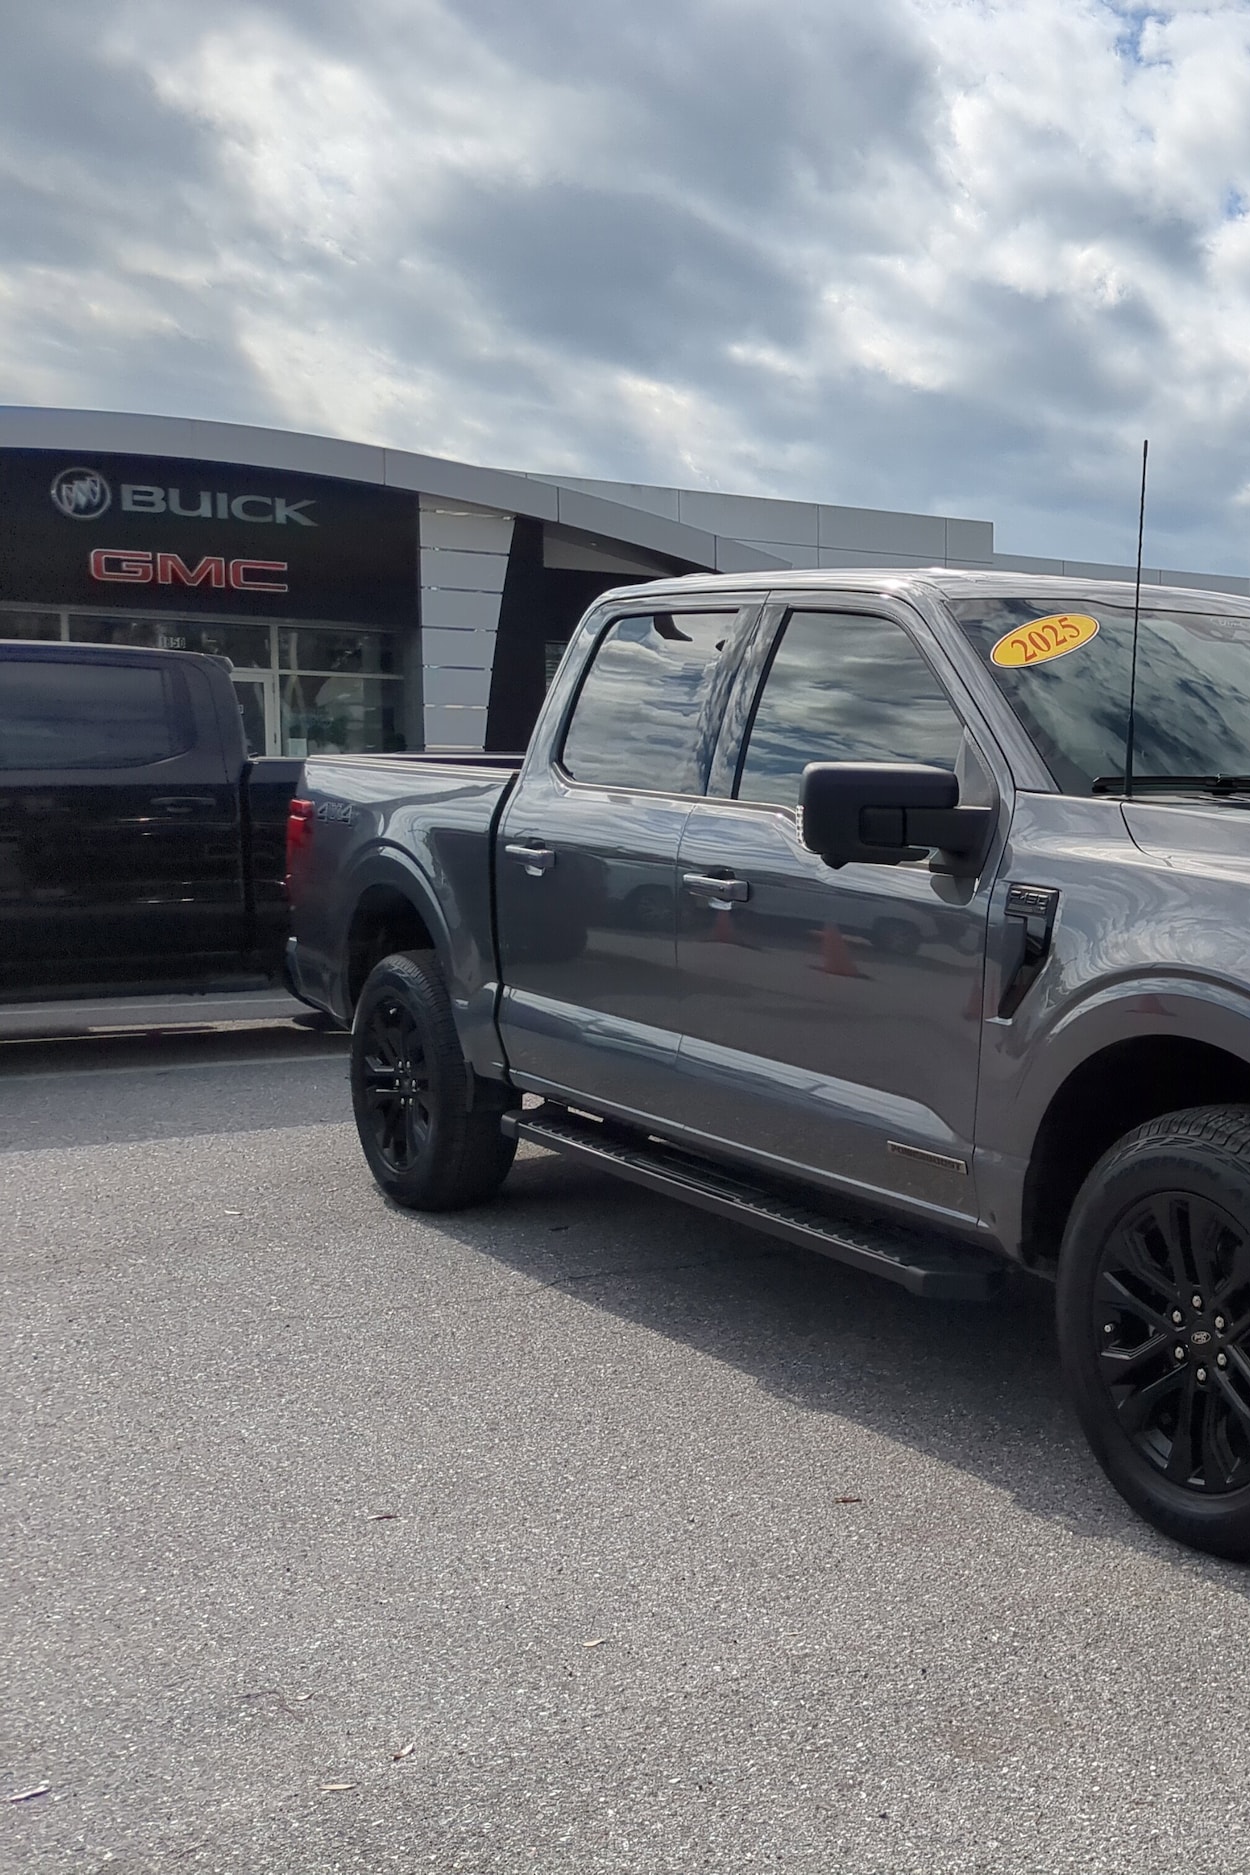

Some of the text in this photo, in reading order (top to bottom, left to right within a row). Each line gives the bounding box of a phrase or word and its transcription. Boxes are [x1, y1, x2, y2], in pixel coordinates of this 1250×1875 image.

[120, 484, 319, 527] BUICK
[90, 548, 289, 592] GMC
[1010, 616, 1081, 662] 2025
